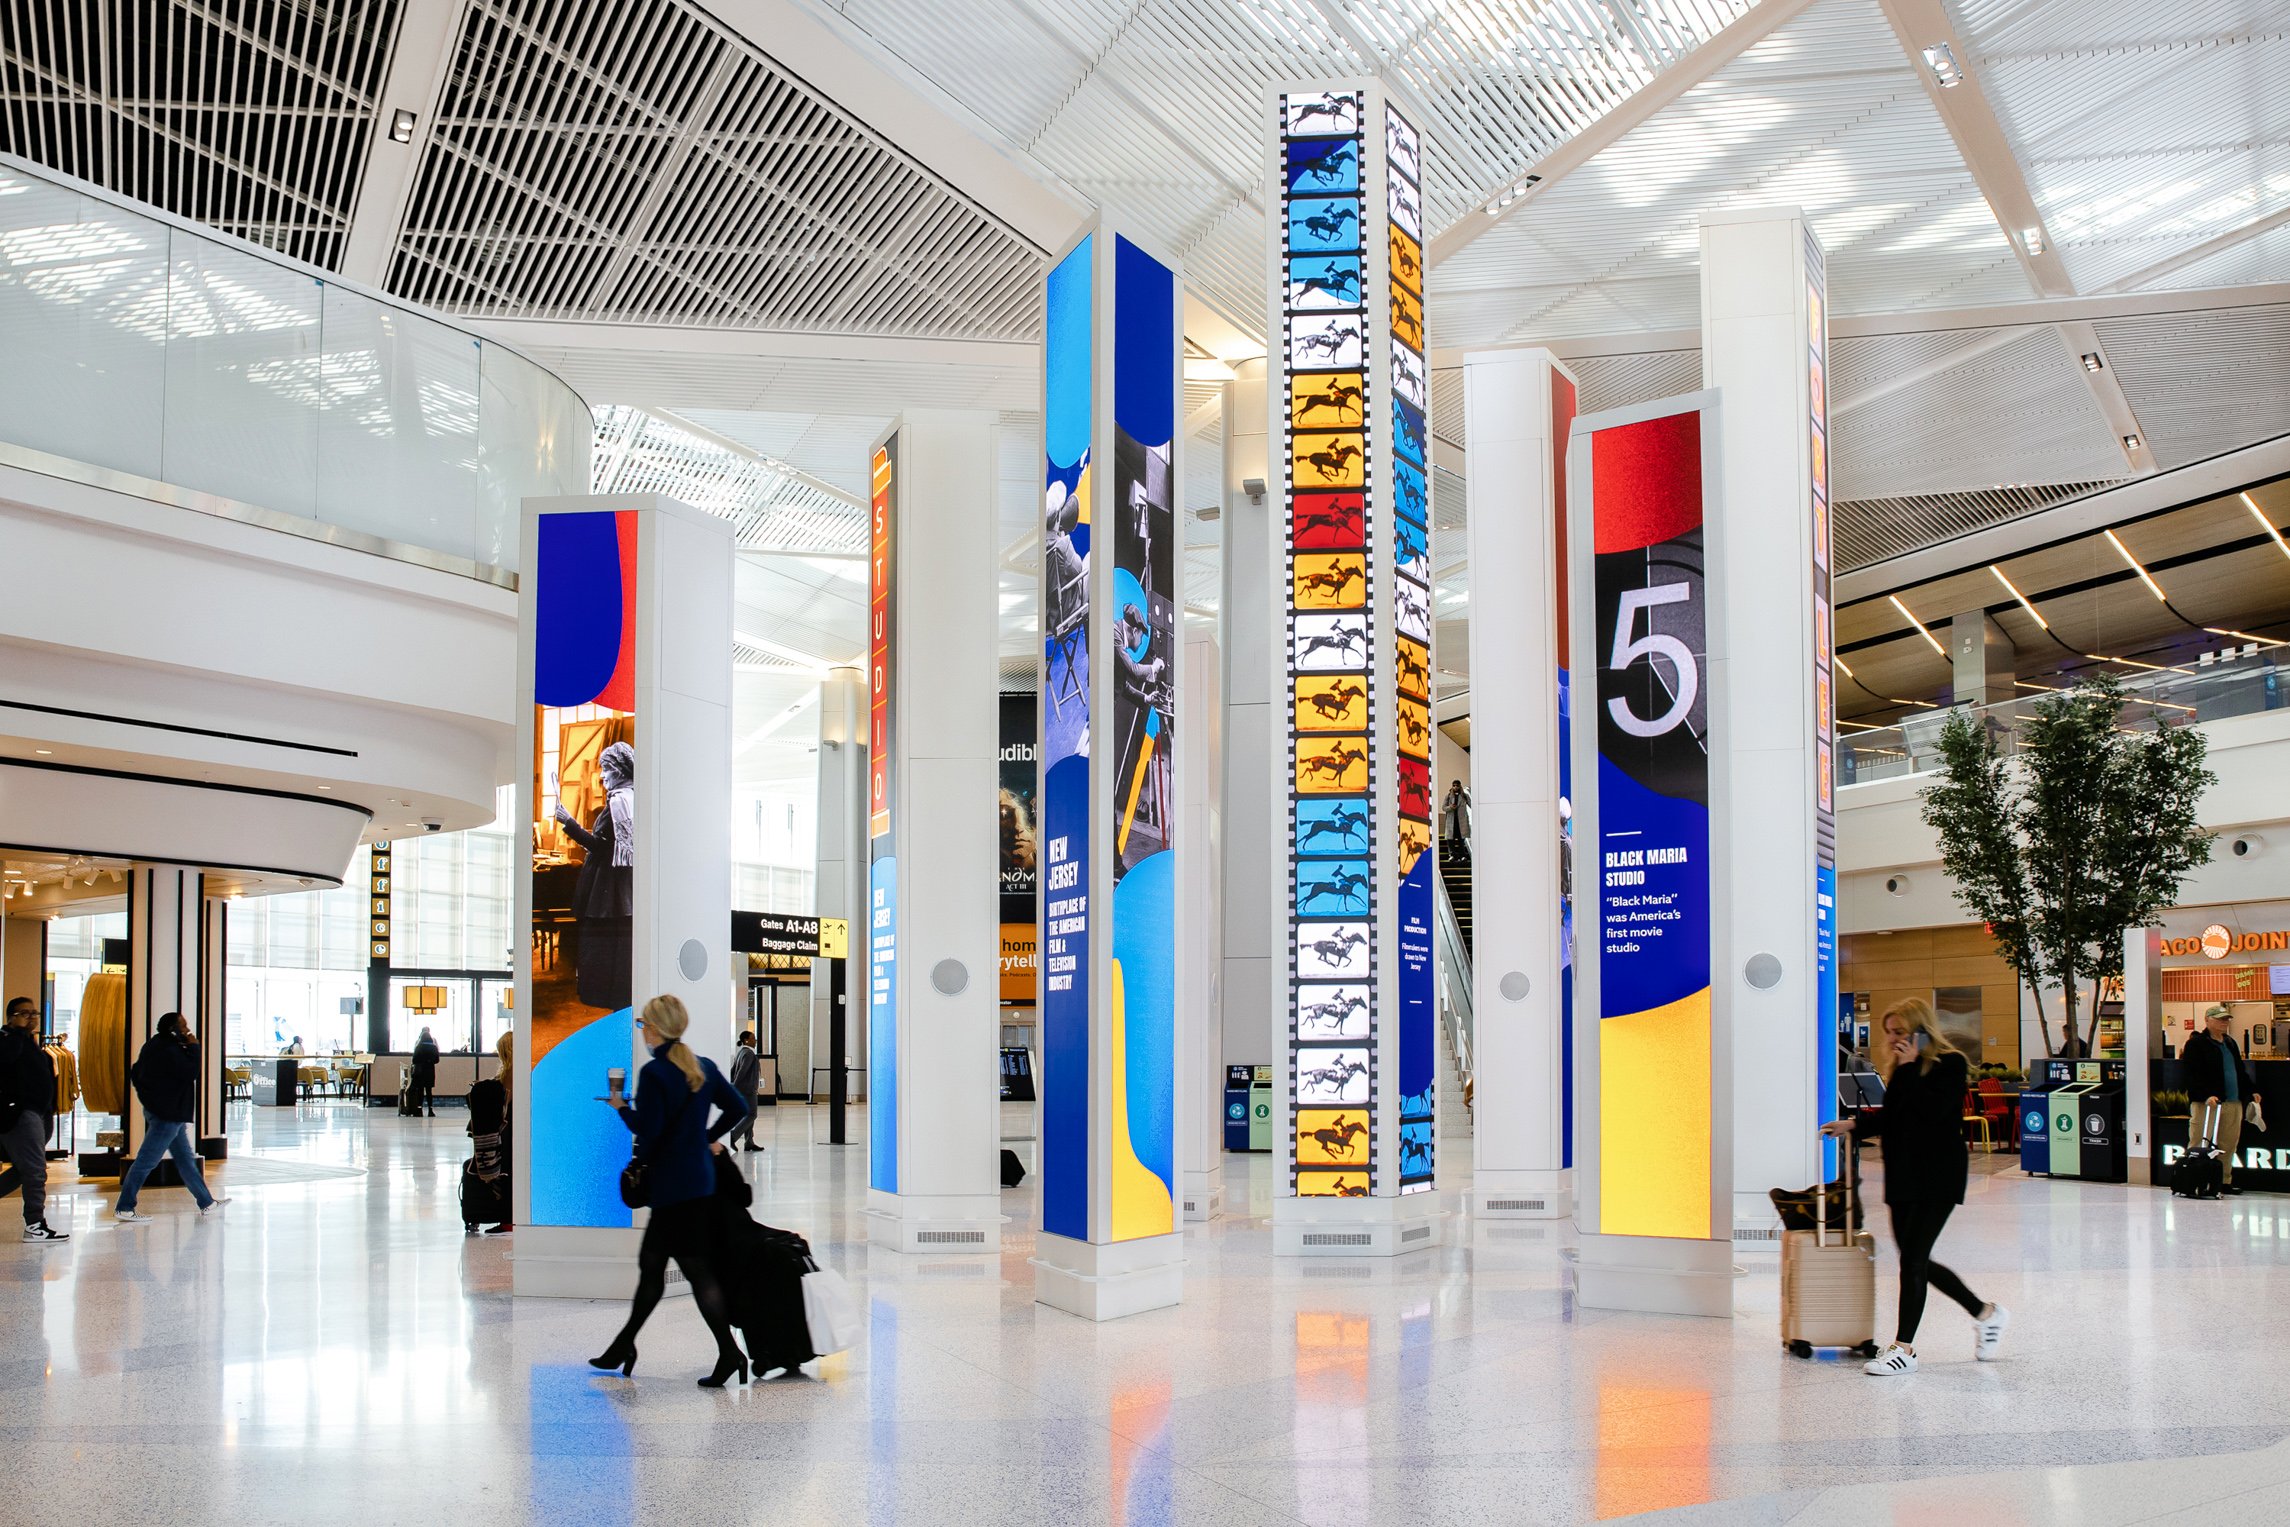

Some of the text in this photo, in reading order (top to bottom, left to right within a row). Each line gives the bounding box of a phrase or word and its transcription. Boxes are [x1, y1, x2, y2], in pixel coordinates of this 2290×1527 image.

[875, 505, 883, 801] STUDIO
[1607, 582, 1698, 738] 5
[1049, 836, 1068, 863] NEW
[1605, 847, 1688, 868] BLACK MARIA
[1048, 861, 1079, 891] JERSEY
[1605, 870, 1645, 887] STUDIO
[1048, 896, 1087, 917] BIRTHPLACE OF
[1606, 893, 1678, 907] "Black Maria"
[1606, 909, 1681, 922] was America's
[761, 919, 818, 934] Gates A1-A8
[1048, 916, 1086, 936] THE AMERICAN
[1606, 926, 1663, 938] first movie
[762, 938, 818, 951] Baggage Claim
[1048, 939, 1061, 954] FILM
[1606, 942, 1640, 953] studio
[2231, 931, 2290, 952] JOIN
[1048, 955, 1076, 972] TELEVISION
[1048, 974, 1072, 991] INDUSTRY
